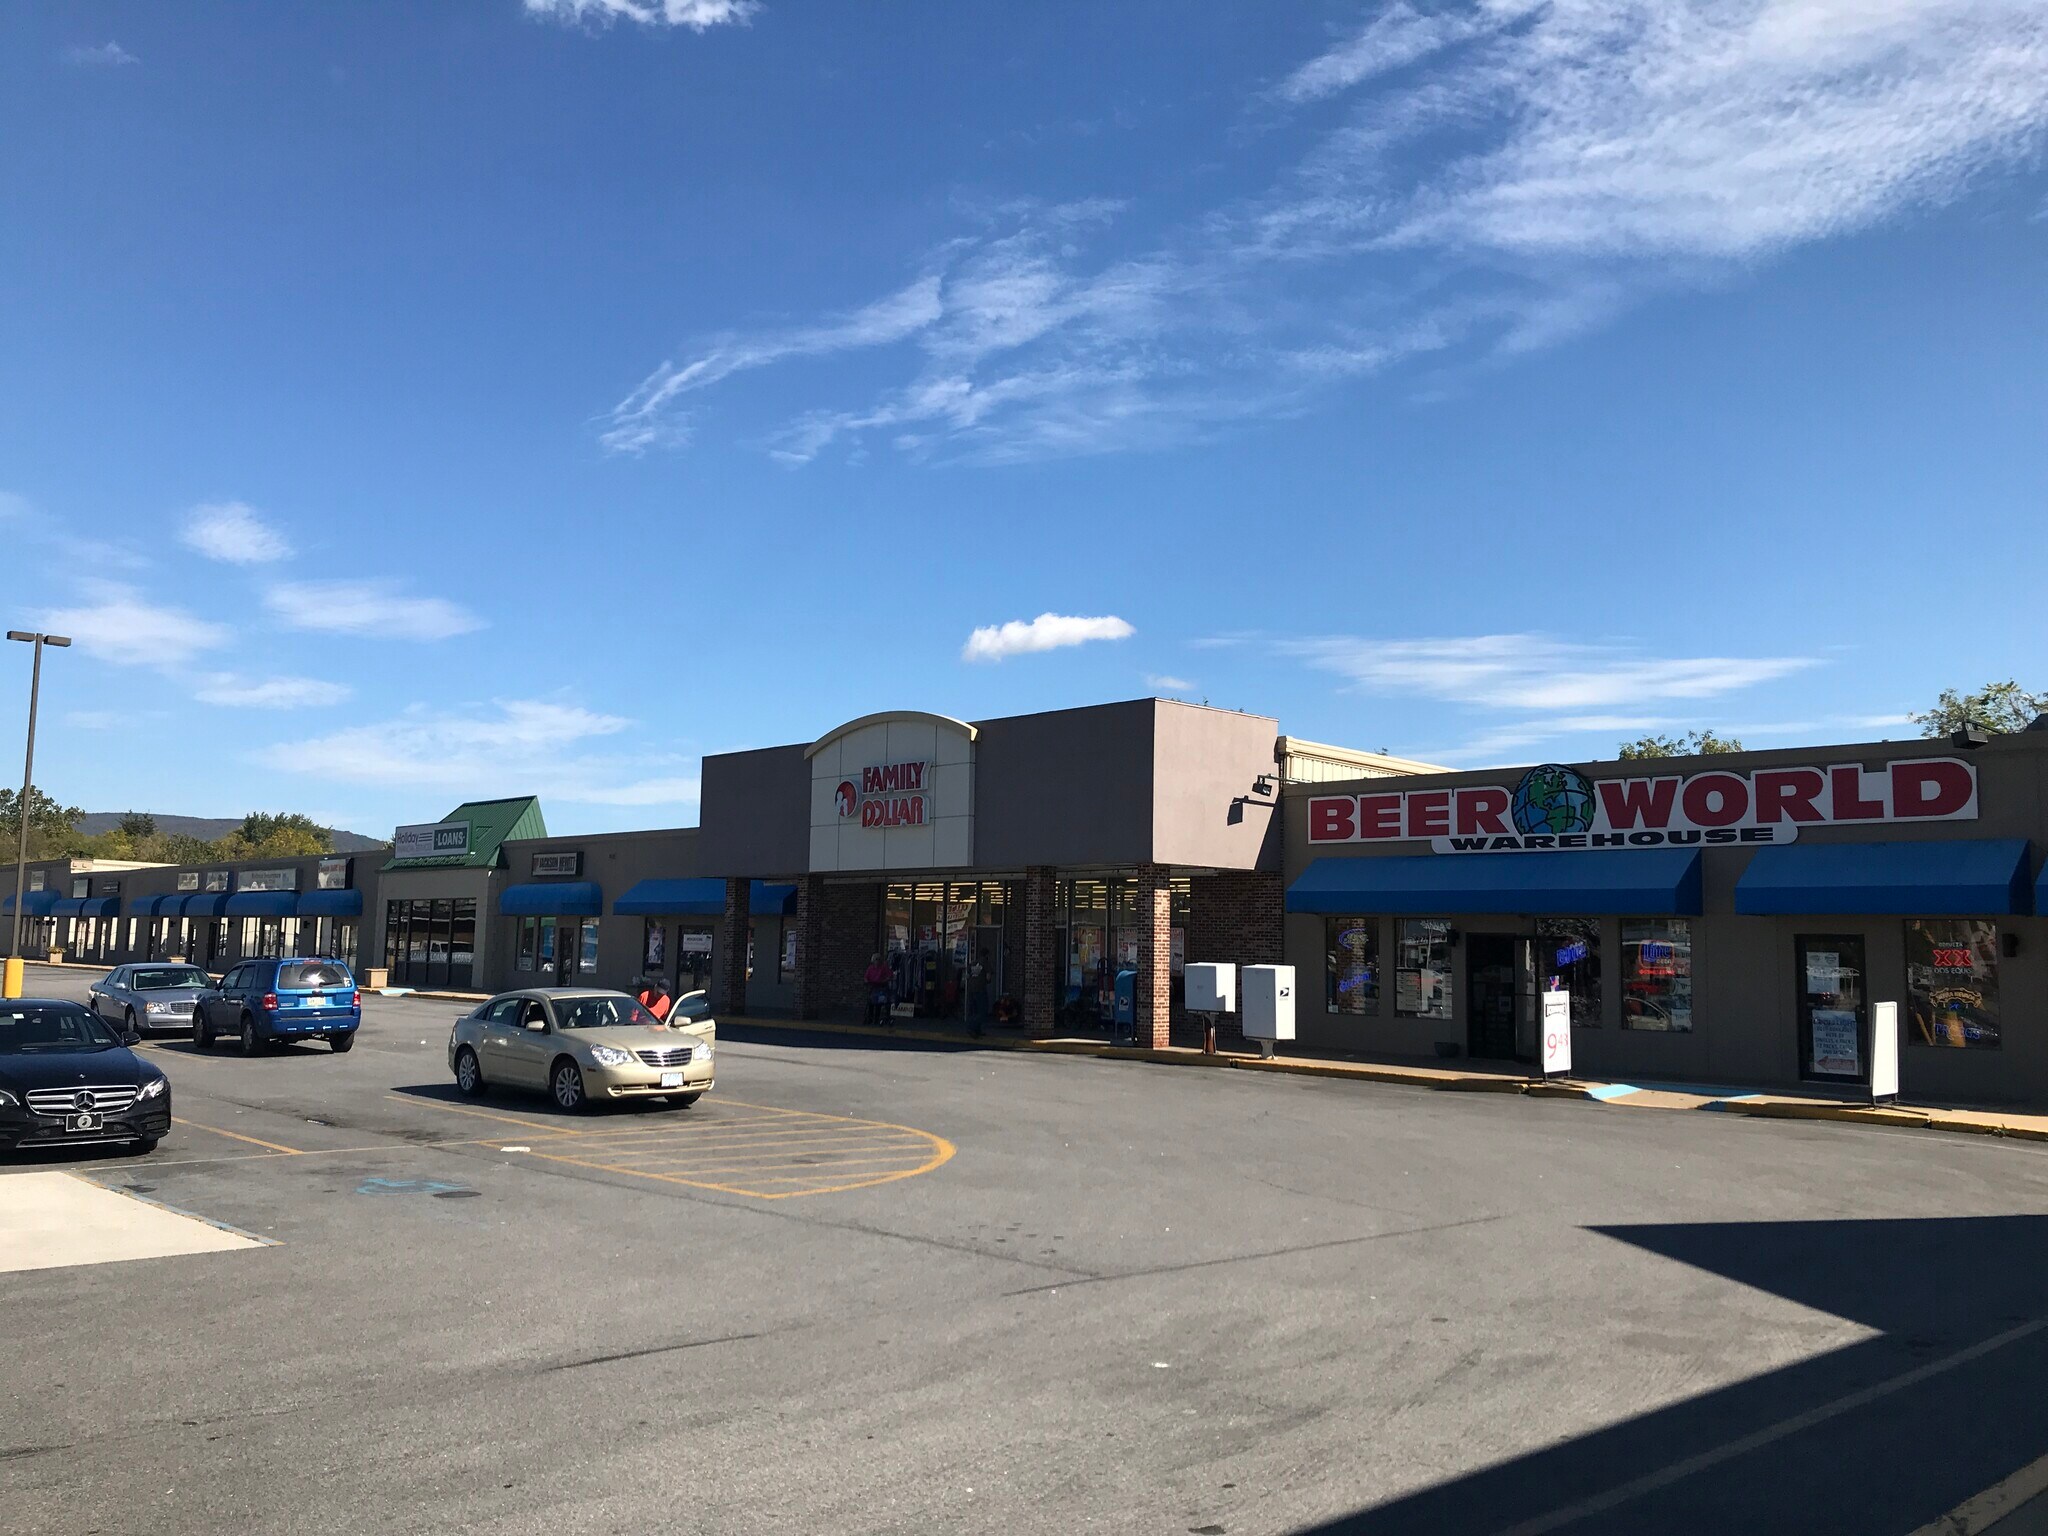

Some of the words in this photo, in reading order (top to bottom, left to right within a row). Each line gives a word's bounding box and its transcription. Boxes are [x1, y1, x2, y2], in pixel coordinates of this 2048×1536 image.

[862, 761, 926, 793] FAMILY
[862, 796, 924, 828] DOLLAR
[1310, 789, 1508, 841] BEER
[1599, 761, 1973, 830] WORLD
[397, 832, 418, 845] Holiday
[437, 831, 464, 847] LOANS
[1449, 827, 1774, 850] WAREHOUSE
[1932, 949, 1972, 967] XX
